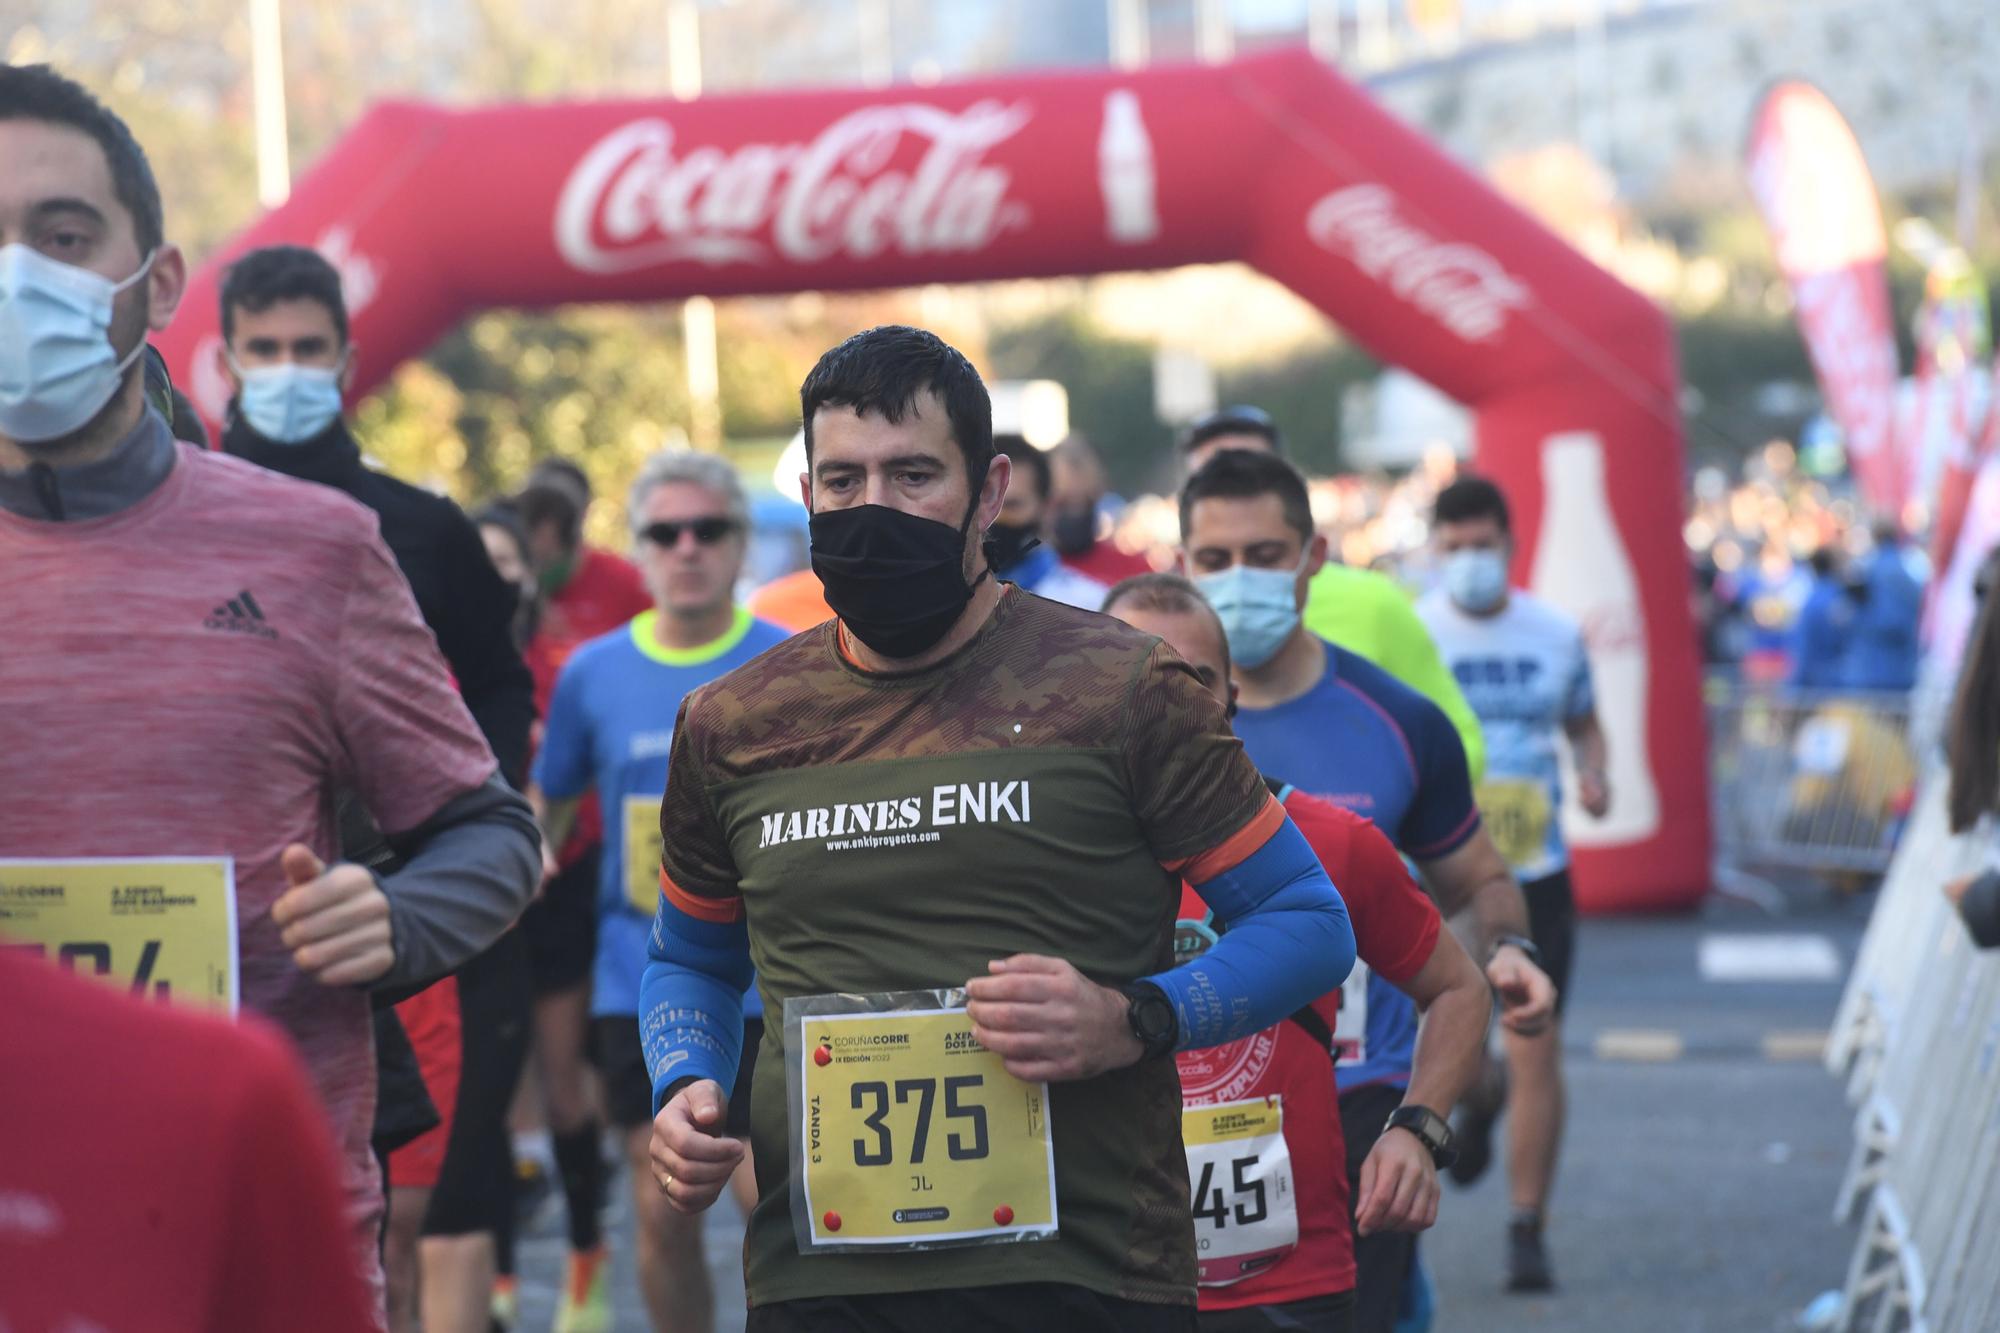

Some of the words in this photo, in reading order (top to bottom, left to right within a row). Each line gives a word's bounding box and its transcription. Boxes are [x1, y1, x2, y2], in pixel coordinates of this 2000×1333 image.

[554, 99, 1034, 273] Coca-Cola
[1306, 183, 1530, 343] Coca-Cola
[759, 797, 921, 848] MARINES
[932, 781, 1030, 826] ENKI
[826, 832, 940, 850] www.enkiproyecto.com
[835, 1034, 910, 1047] CORUÑACORRE
[1216, 1036, 1272, 1102] POPULAR
[811, 1096, 821, 1150] TANDA
[851, 1075, 989, 1166] 375
[813, 1155, 821, 1163] 3
